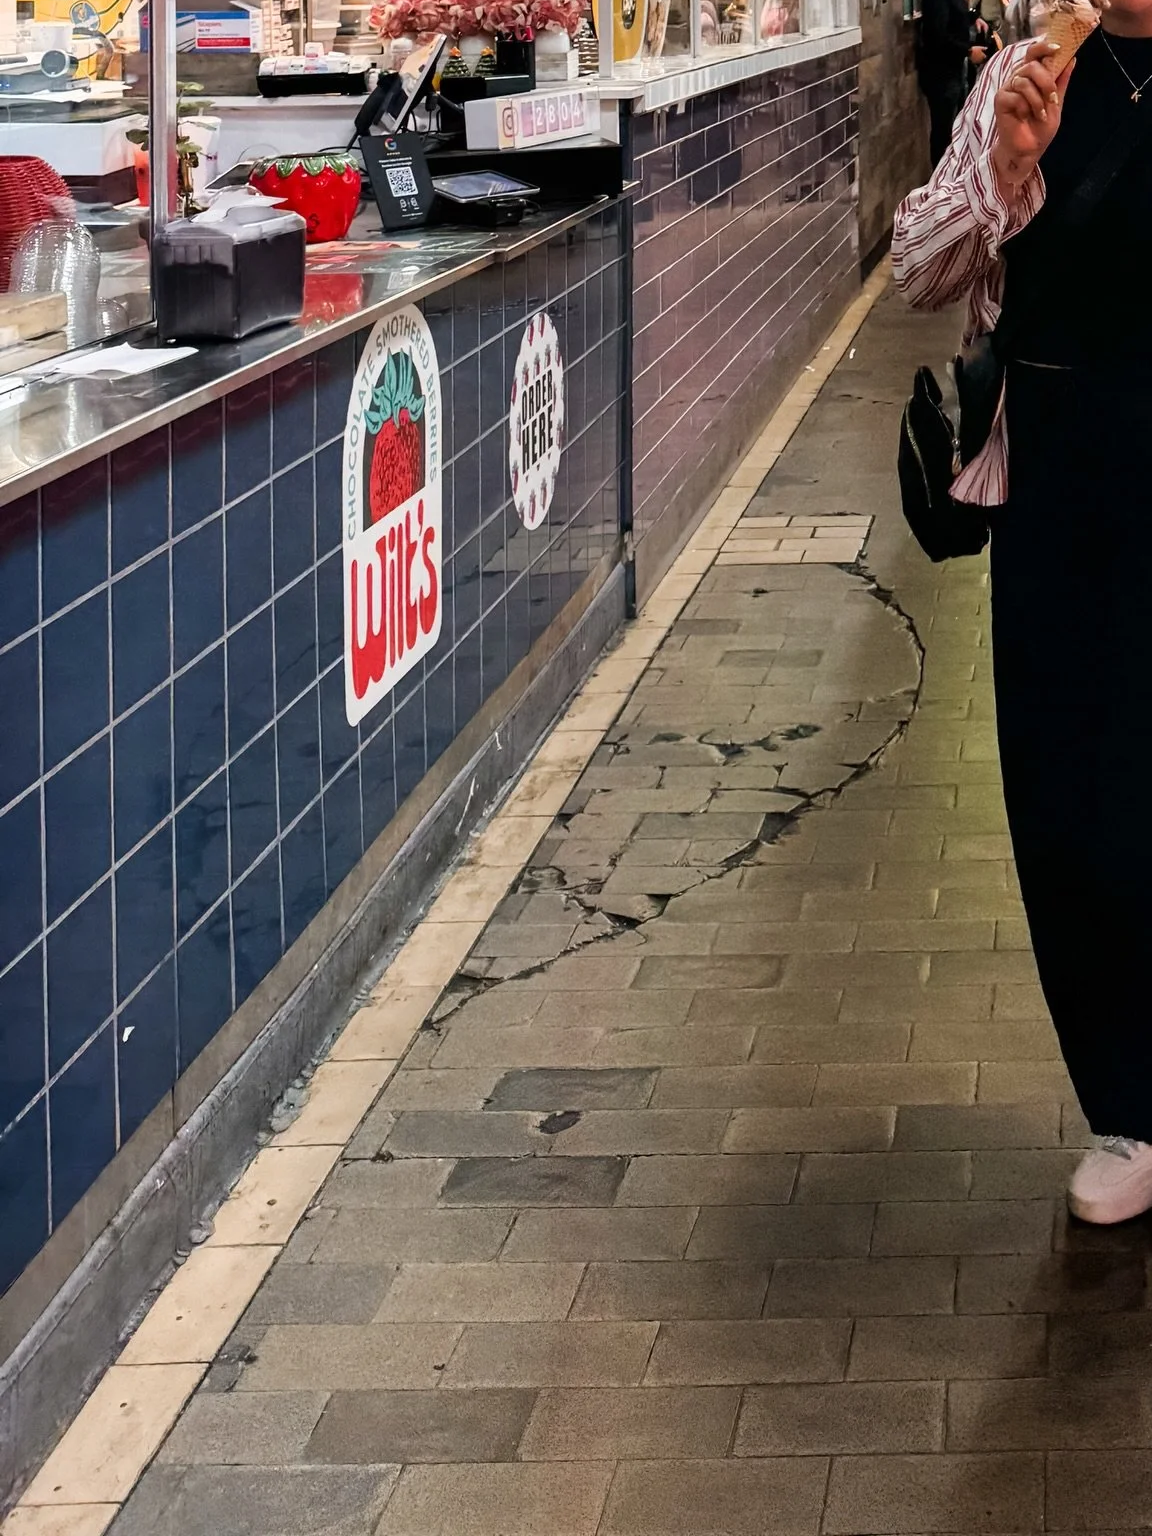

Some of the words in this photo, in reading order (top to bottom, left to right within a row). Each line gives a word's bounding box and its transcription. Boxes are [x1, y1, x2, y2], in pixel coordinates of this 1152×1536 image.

[536, 101, 582, 127] 2804
[347, 355, 375, 541] CHOCOLATE
[376, 314, 431, 371] SMOTHERED
[425, 372, 438, 484] BERRIES
[521, 369, 554, 426] ORDER
[522, 404, 555, 476] HERE
